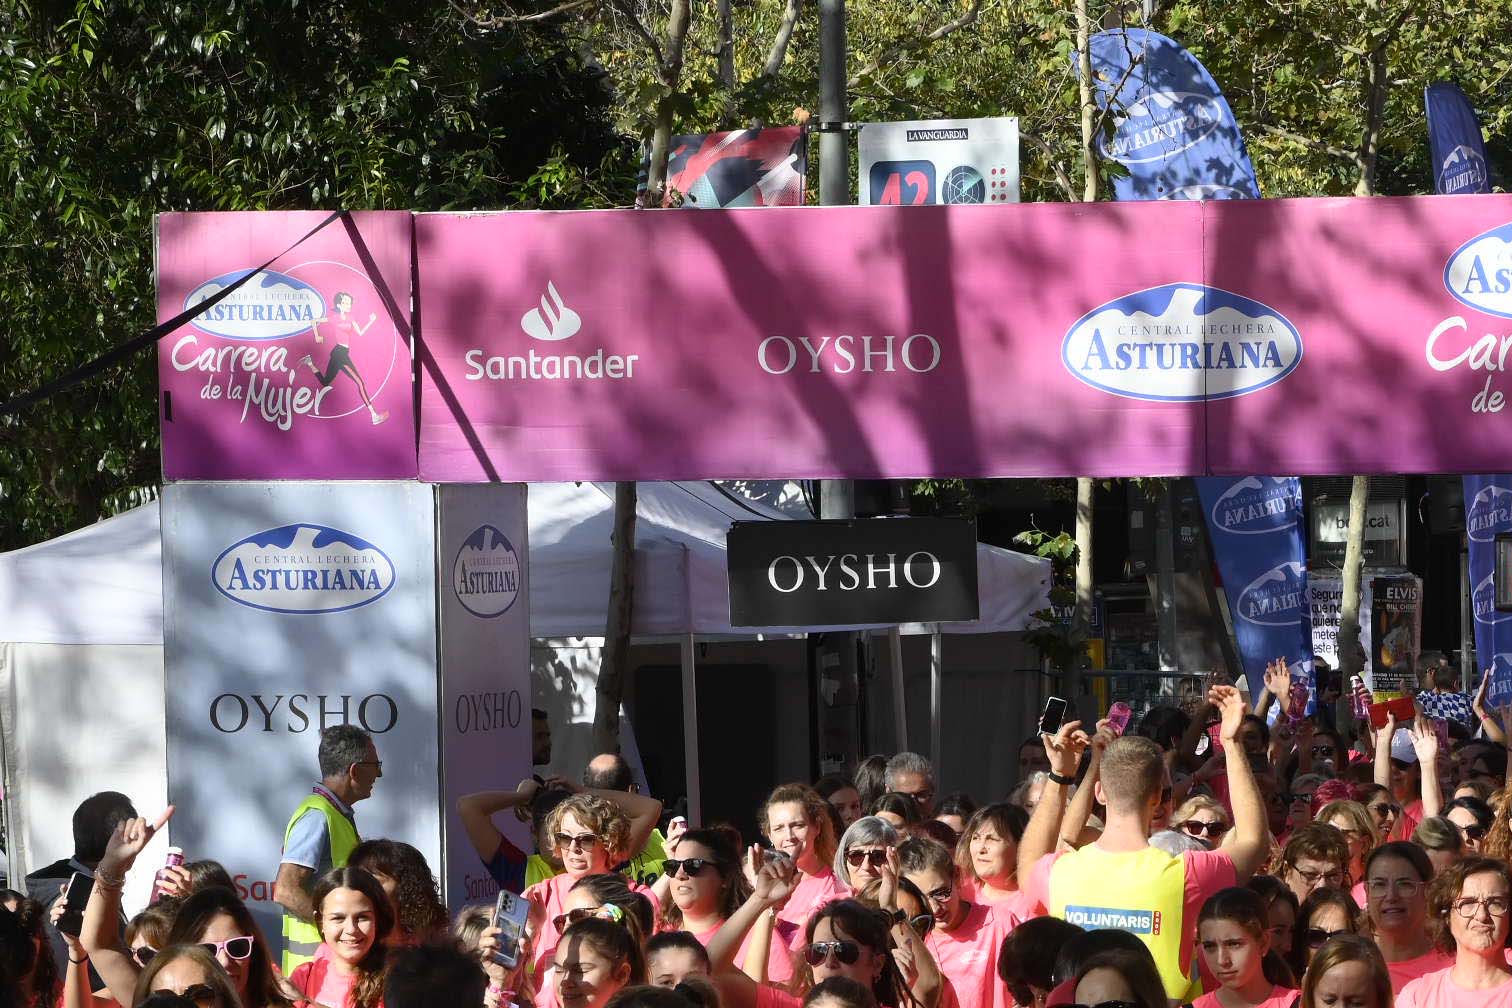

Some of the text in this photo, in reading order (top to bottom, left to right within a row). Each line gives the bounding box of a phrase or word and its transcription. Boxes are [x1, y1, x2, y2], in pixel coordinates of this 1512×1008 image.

[1117, 322, 1275, 336] CENTRAL LECHERA
[171, 334, 291, 373] Carrera
[465, 348, 639, 380] Santander
[756, 334, 942, 376] OYSHO
[1081, 327, 1284, 371] ASTURIANA
[200, 368, 334, 431] de la Mujer
[1471, 374, 1506, 413] de
[226, 557, 383, 592] ASTURIANA
[254, 555, 376, 565] CENTRAL LECHERA
[458, 559, 517, 595] ASTURIANA
[767, 551, 942, 593] OYSHO
[1312, 602, 1327, 615] que
[1386, 587, 1418, 600] ELVIS
[209, 693, 399, 735] OYSHO
[456, 689, 522, 734] OYSHO
[1065, 910, 1151, 929] VOLUNTARIS
